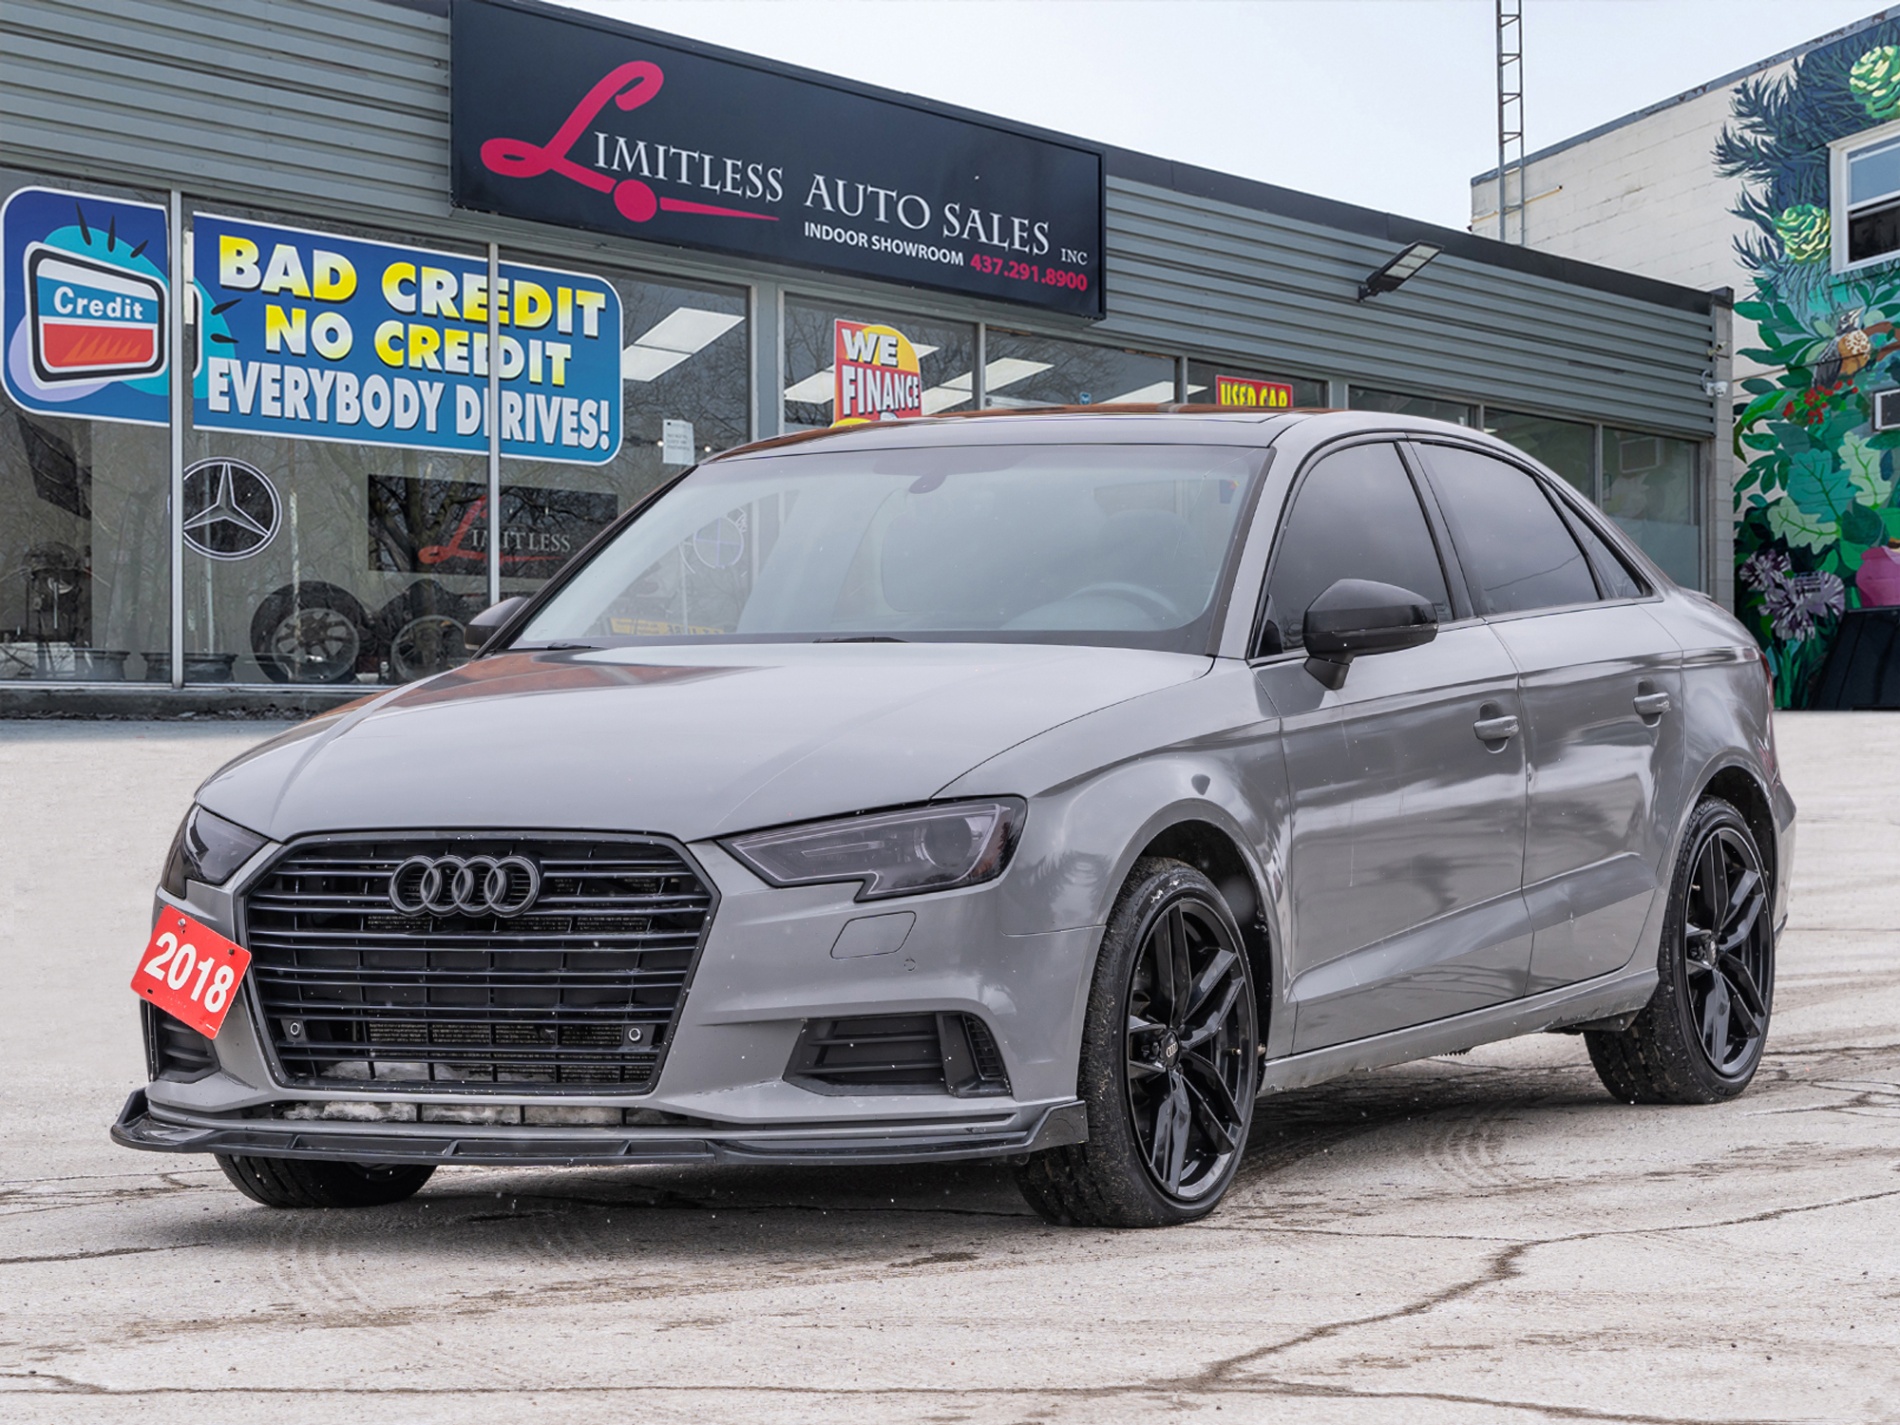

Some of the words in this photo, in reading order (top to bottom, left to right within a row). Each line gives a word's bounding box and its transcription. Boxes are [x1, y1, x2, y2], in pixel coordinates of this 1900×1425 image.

[480, 60, 784, 212] LIMITLESS
[804, 173, 931, 230] AUTO
[943, 202, 1050, 256] SALES
[1061, 248, 1088, 265] INC
[219, 234, 358, 304] BAD
[381, 261, 606, 338] CREDIT
[805, 221, 869, 248] INDOOR
[871, 235, 965, 267] SHOWROOM
[970, 253, 1088, 291] 437.291.8900
[53, 285, 144, 321] Credit
[265, 304, 354, 361] NO
[374, 320, 572, 386] CREDIT
[841, 328, 898, 367] WE
[208, 356, 445, 432] EVERYBODY
[456, 384, 611, 451] DRIVES!
[842, 364, 919, 416] FINANCE
[1220, 382, 1257, 406] USED
[143, 931, 235, 1014] 2018
